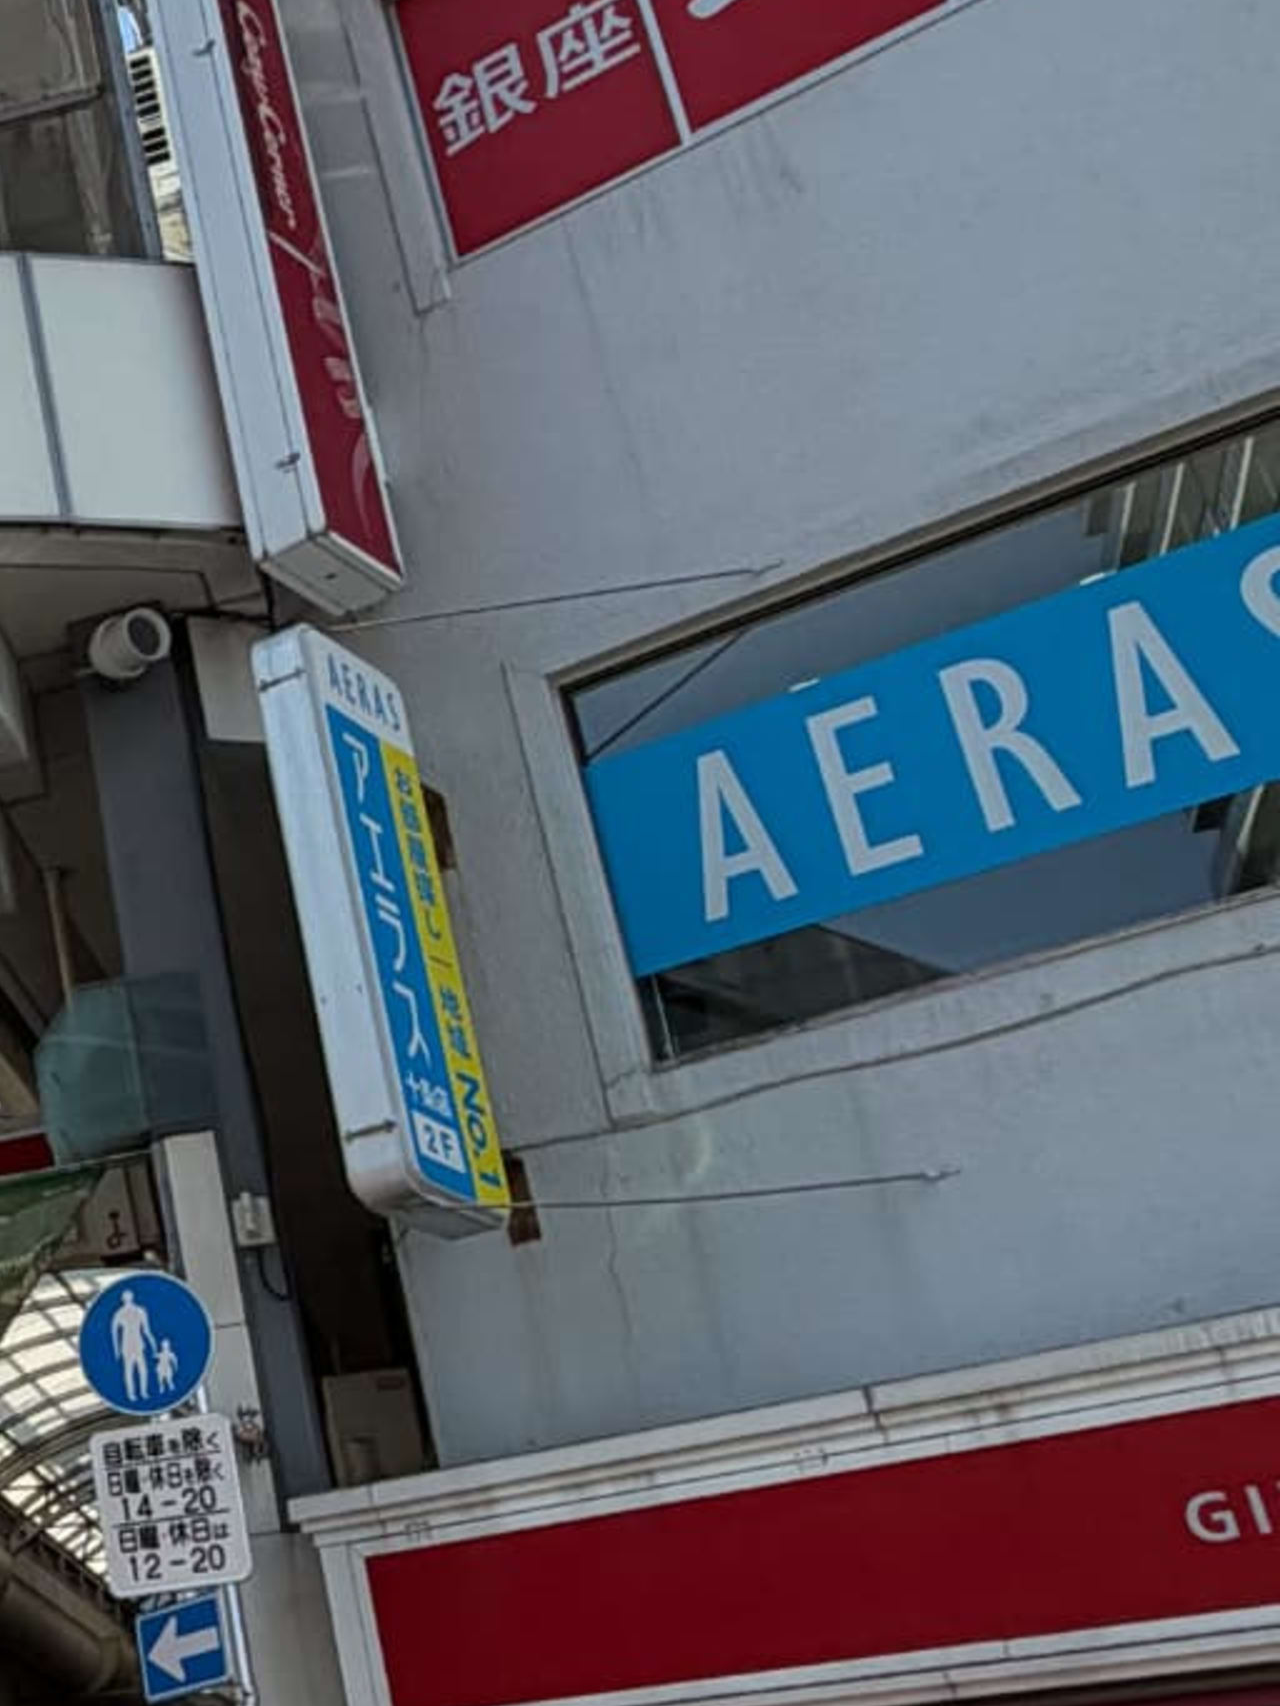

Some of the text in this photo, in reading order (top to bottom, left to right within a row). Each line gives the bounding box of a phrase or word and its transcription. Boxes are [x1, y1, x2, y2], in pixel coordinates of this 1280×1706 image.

[328, 651, 400, 732] AERAS
[102, 1425, 221, 1469] 自転車を除く
[120, 1486, 218, 1521] 14-20
[1185, 1480, 1280, 1542] GI
[127, 1546, 226, 1582] 12-20
